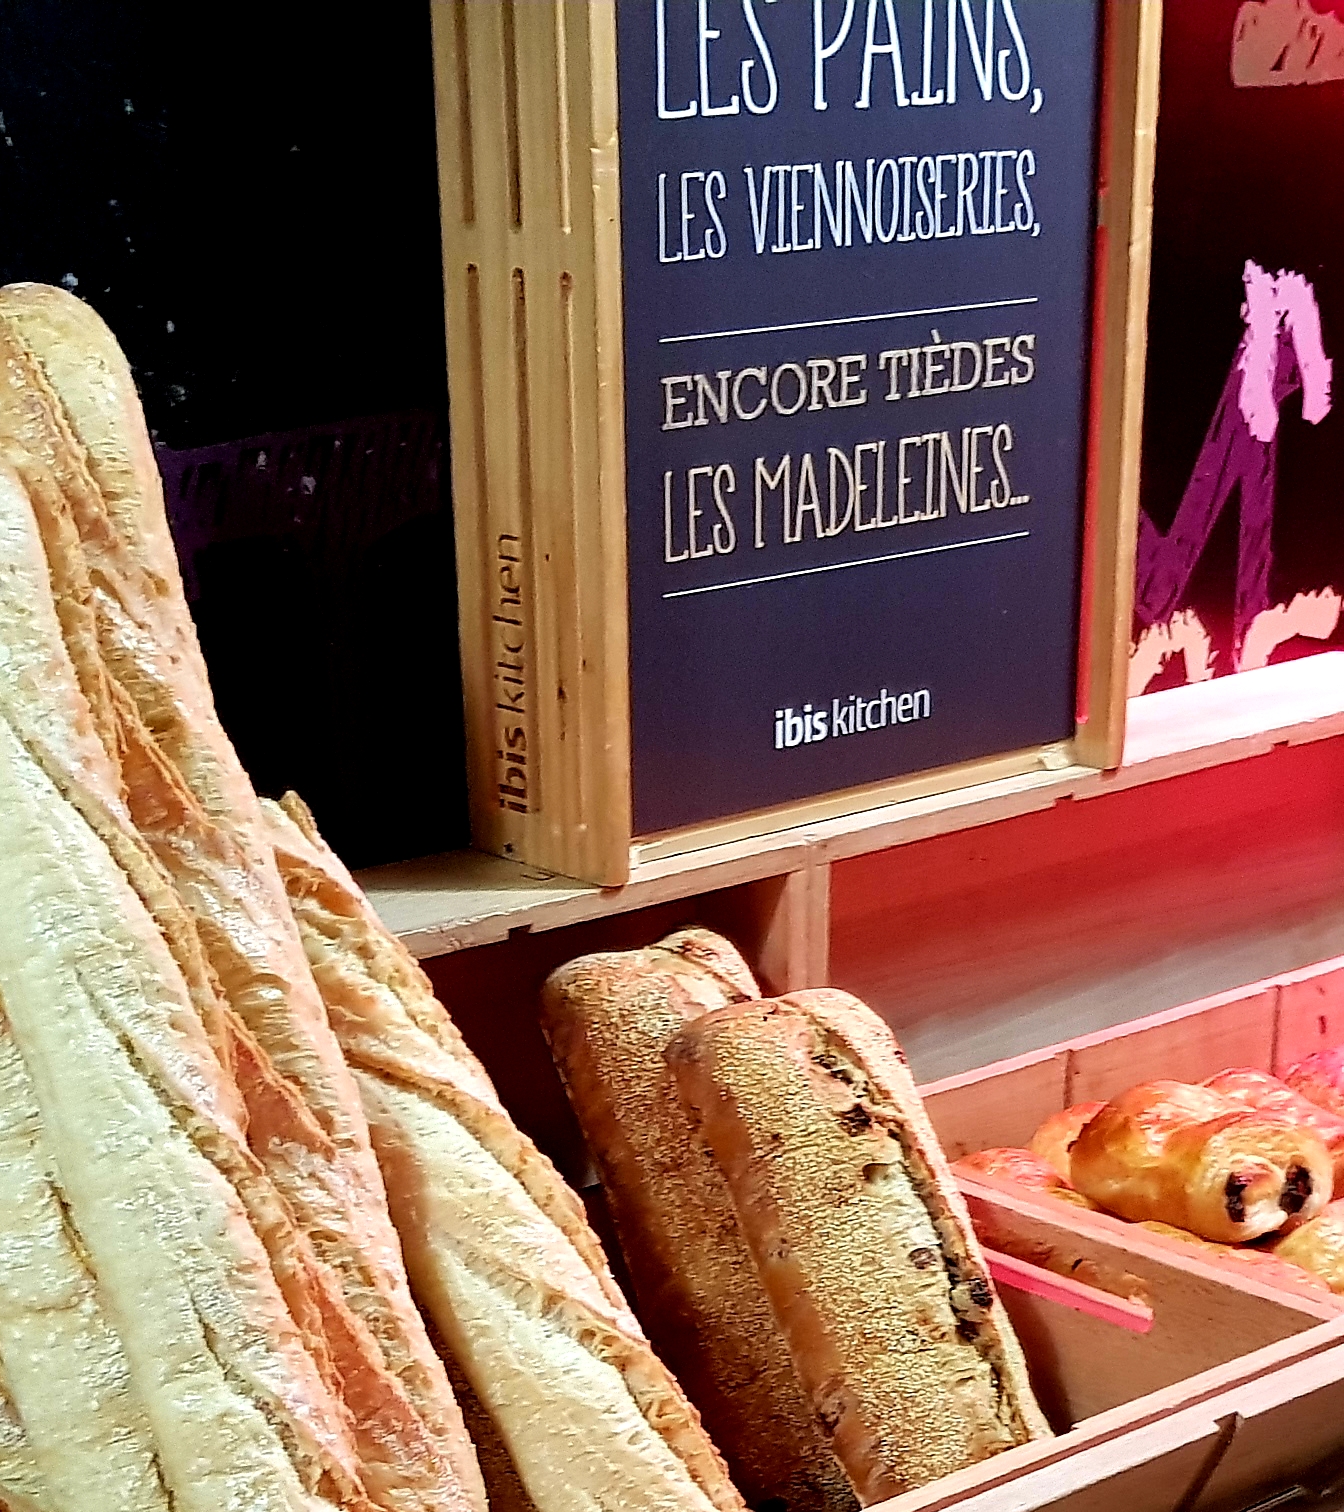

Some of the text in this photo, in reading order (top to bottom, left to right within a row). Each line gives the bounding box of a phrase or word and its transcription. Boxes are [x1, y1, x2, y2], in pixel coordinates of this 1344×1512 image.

[657, 0, 1045, 121] LES PAINS,
[658, 149, 1042, 265] LES VIENNOISERIES,
[662, 329, 1037, 432] ENCORE TIÈDES
[663, 462, 736, 564] LES
[492, 533, 528, 814] ibis kitchen
[775, 687, 932, 750] ibis kitchen
